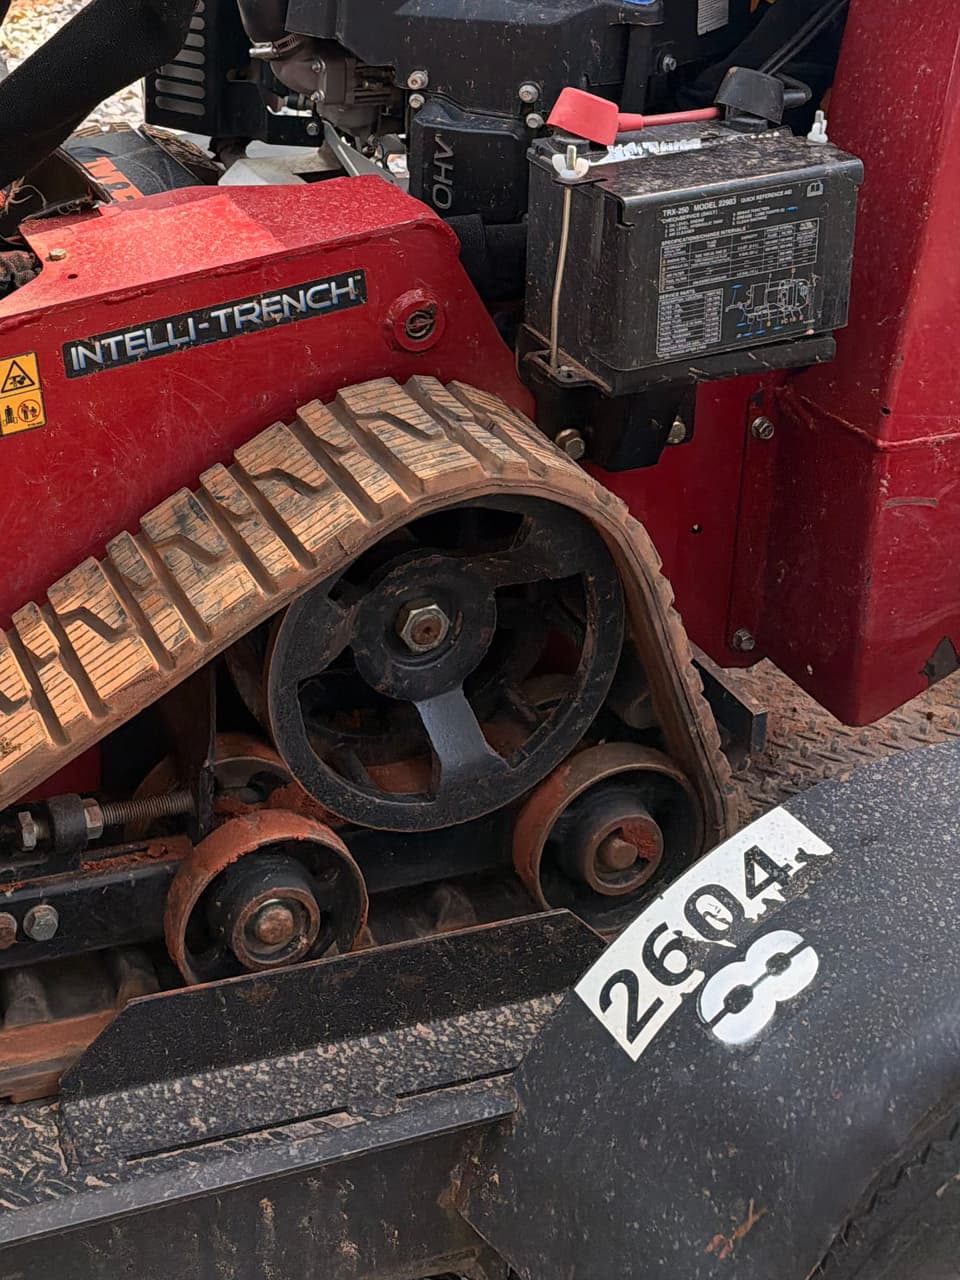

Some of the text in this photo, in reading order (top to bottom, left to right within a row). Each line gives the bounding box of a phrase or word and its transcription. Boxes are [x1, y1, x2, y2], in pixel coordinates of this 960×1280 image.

[432, 133, 454, 210] OHV
[662, 206, 689, 217] TRX-250
[693, 201, 717, 211] MODEL
[756, 190, 783, 200] REFERENCE
[599, 845, 792, 1043] 2604
